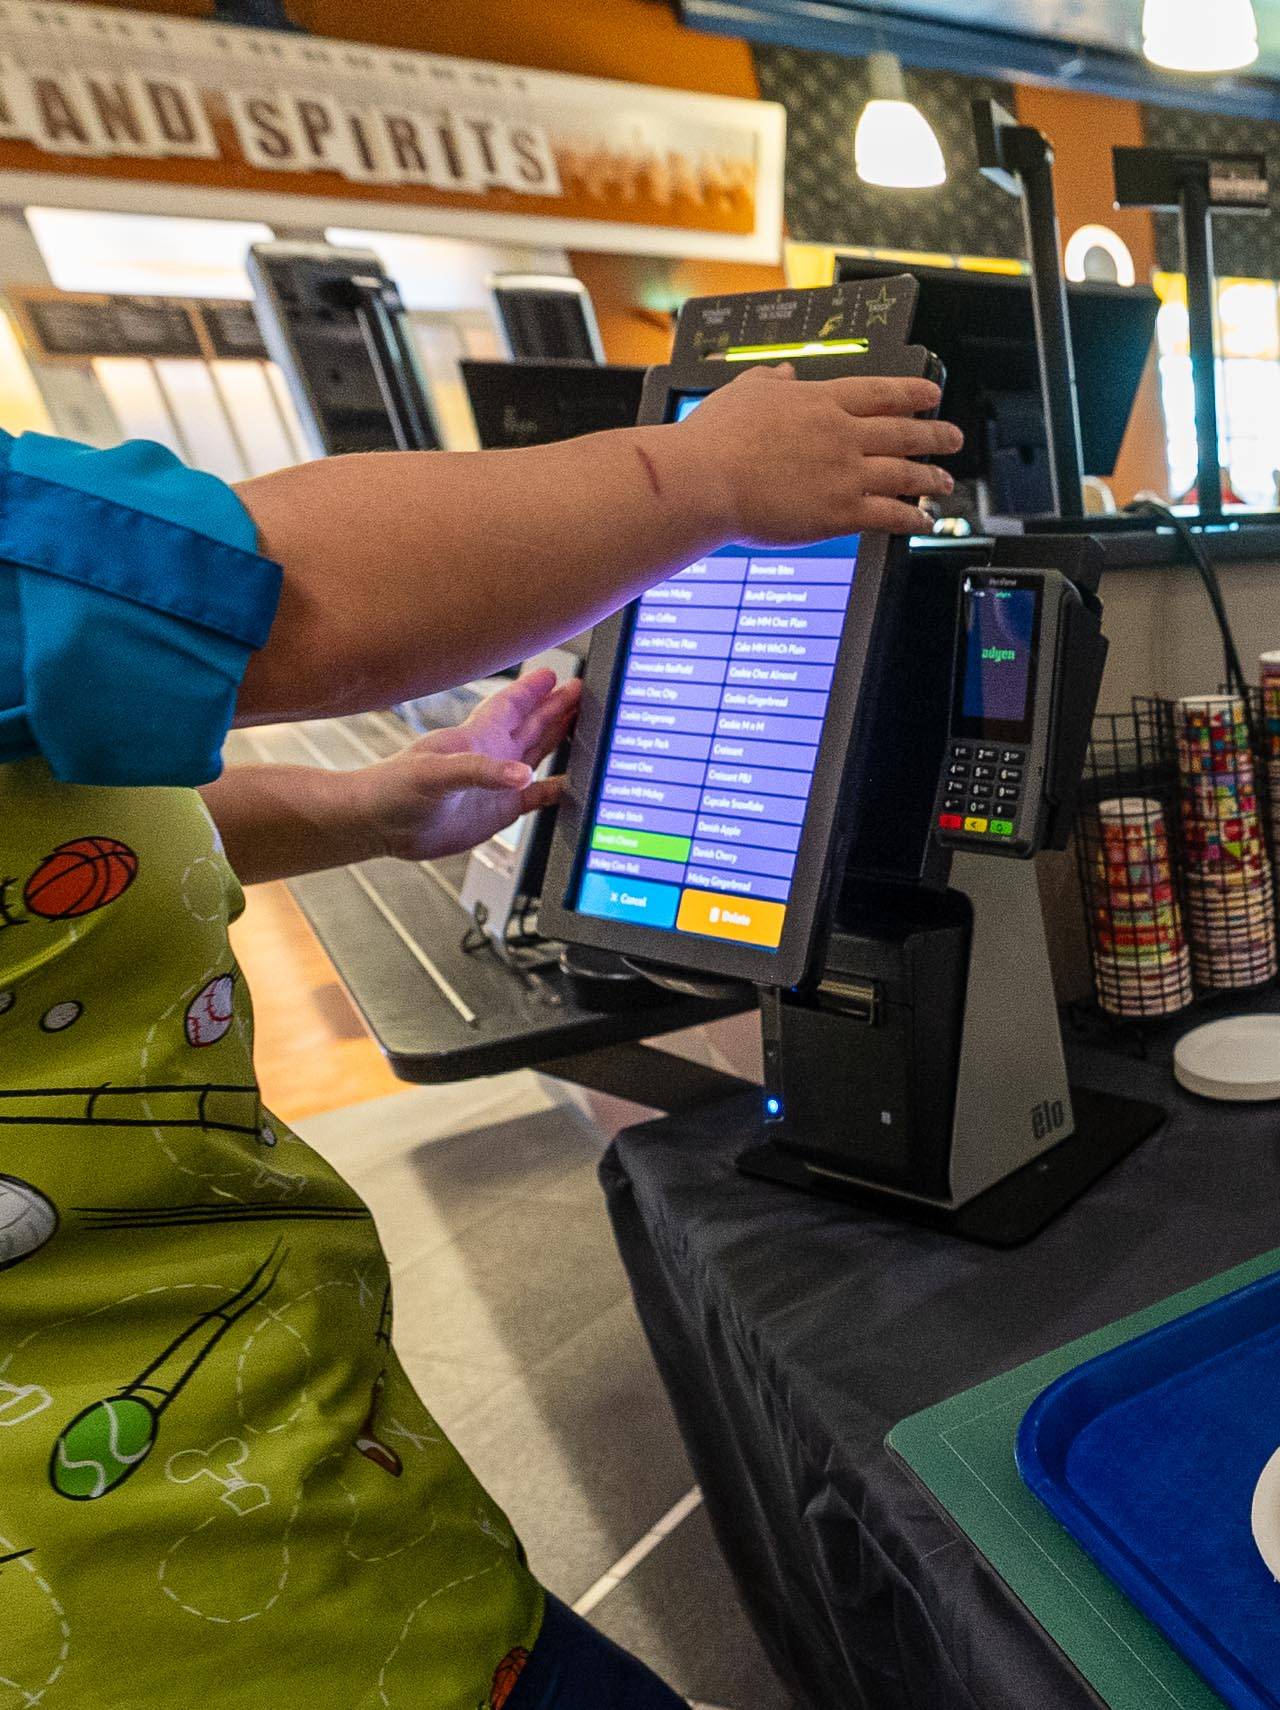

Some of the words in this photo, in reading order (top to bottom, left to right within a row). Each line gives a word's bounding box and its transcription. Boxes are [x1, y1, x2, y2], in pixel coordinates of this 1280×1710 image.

[33, 78, 196, 145] AND
[245, 98, 547, 184] SPIRITS
[981, 646, 1016, 663] adyen
